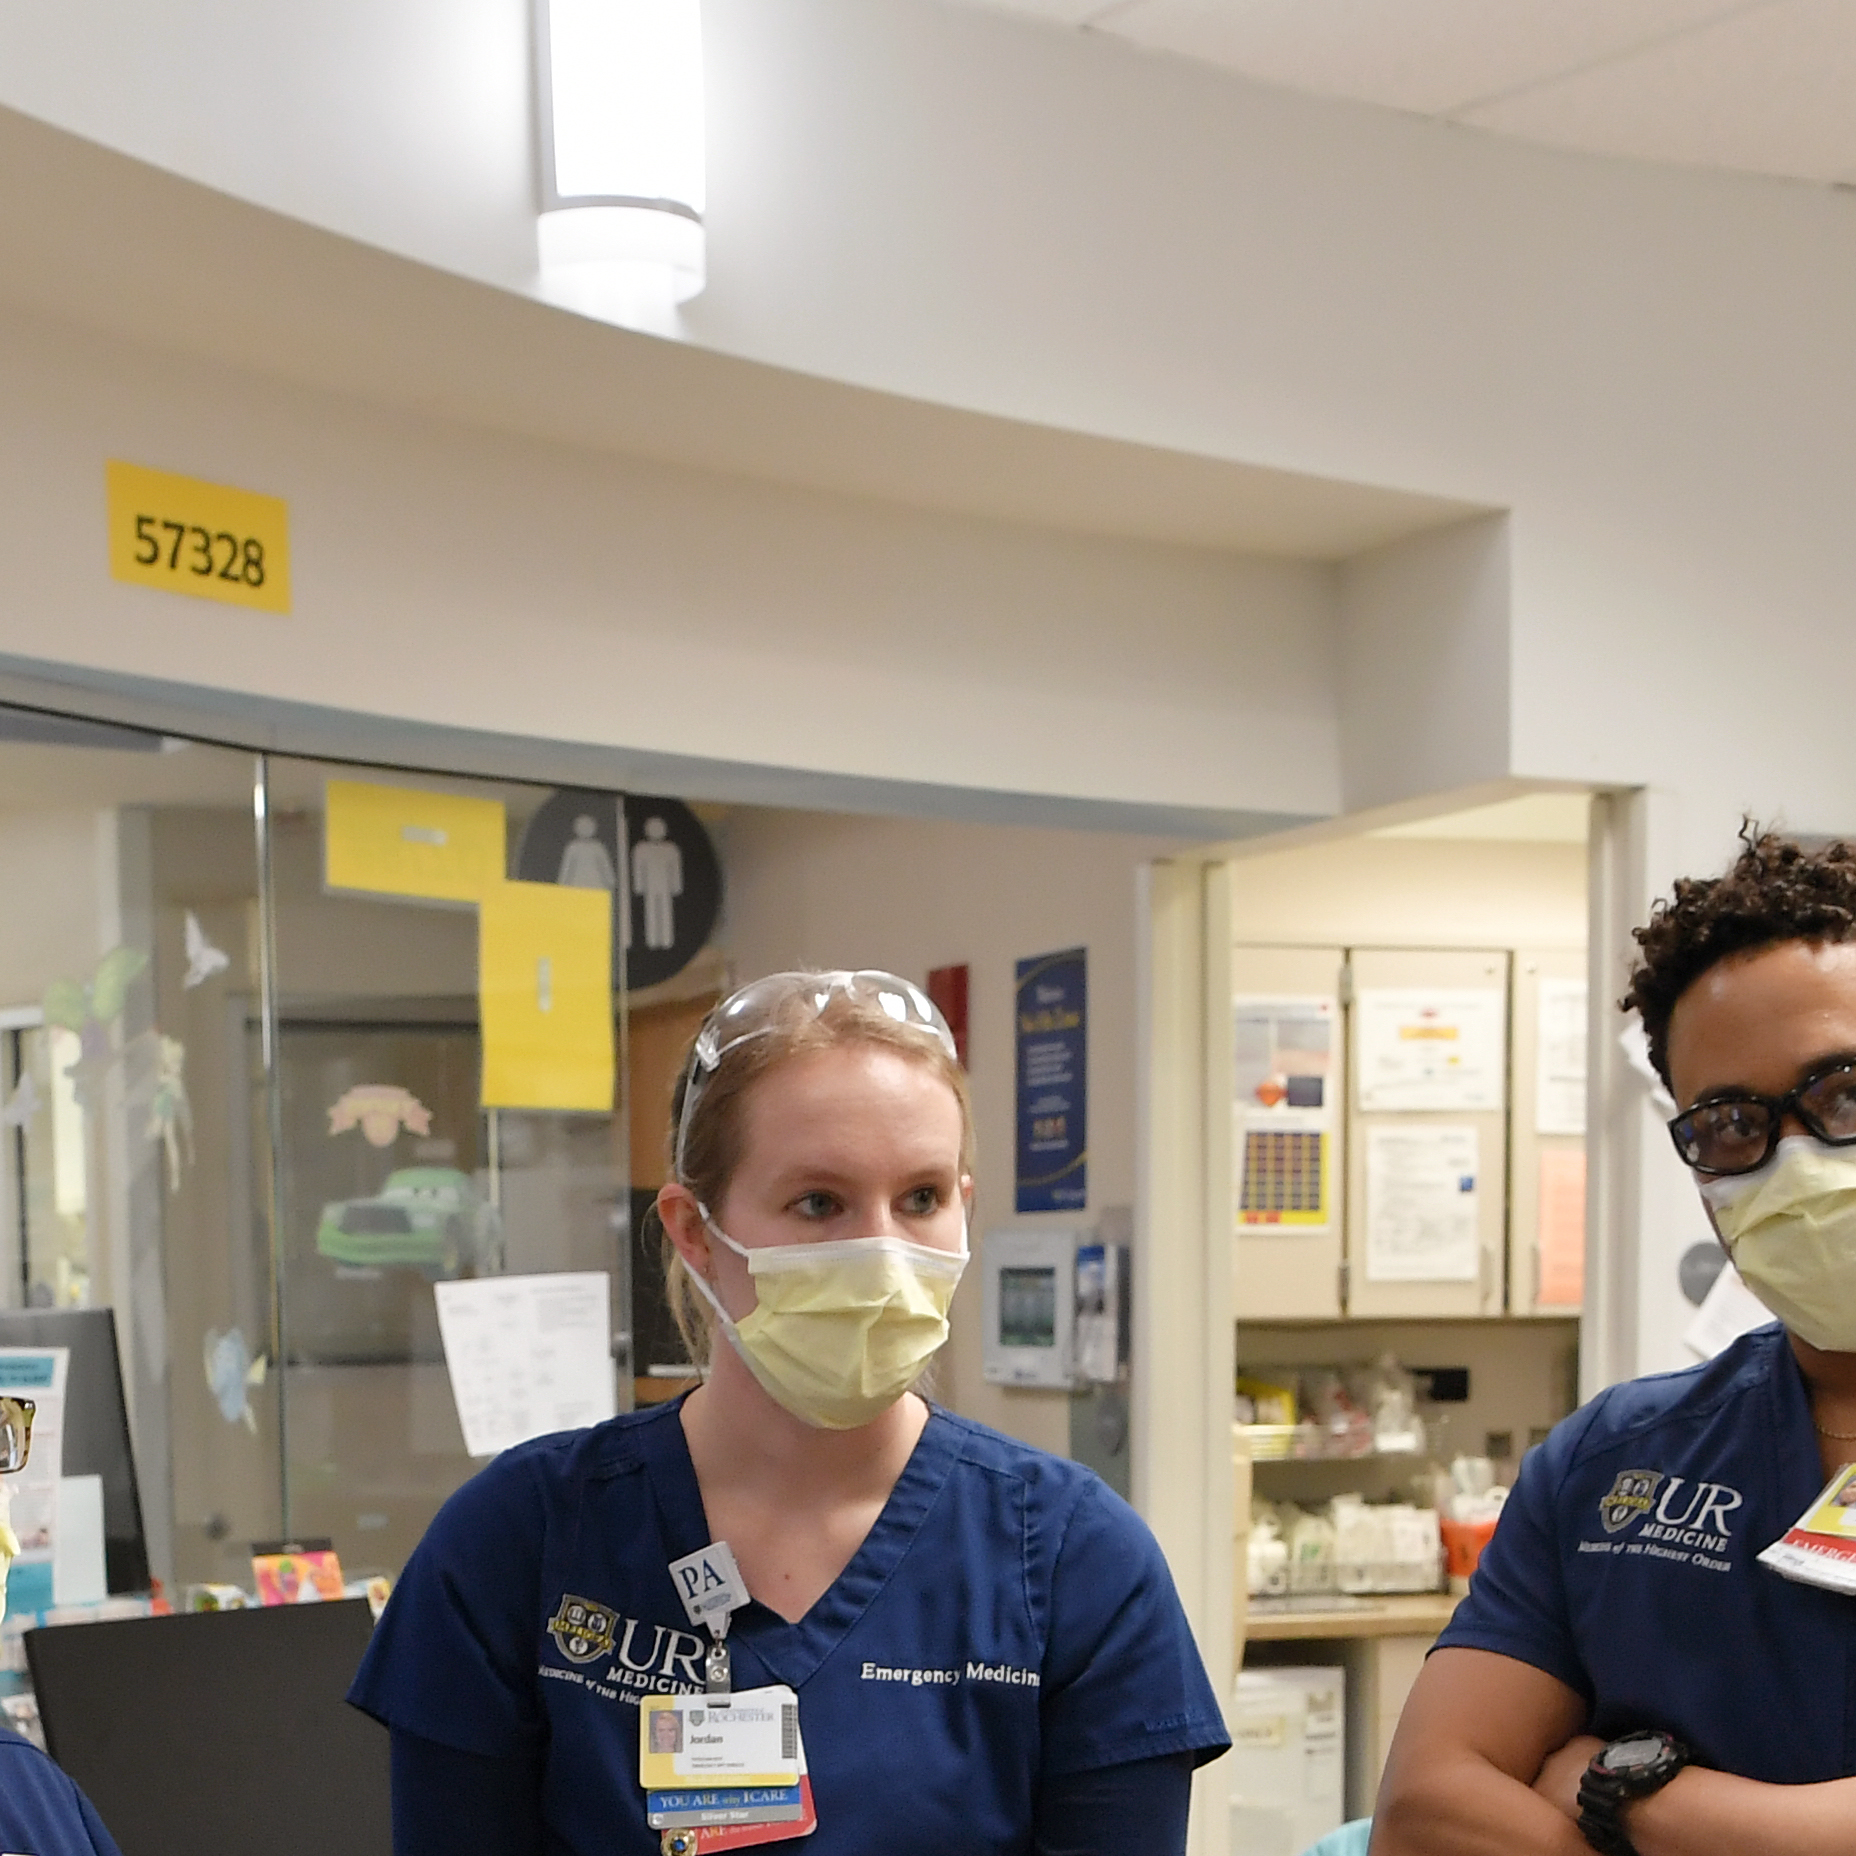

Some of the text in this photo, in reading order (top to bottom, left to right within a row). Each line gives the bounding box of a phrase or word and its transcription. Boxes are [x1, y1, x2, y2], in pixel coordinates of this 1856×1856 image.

[136, 514, 265, 587] 57328
[1655, 1477, 1743, 1537] UR
[1638, 1522, 1728, 1552] MEDICINE
[678, 1558, 726, 1600] PA
[619, 1618, 707, 1685] UR
[606, 1666, 707, 1696] MEDICINE
[861, 1661, 1041, 1687] Emergency Medicin
[690, 1734, 724, 1745] Jordan
[660, 1796, 691, 1809] YOU
[693, 1793, 719, 1806] ARE
[701, 1826, 726, 1839] ARE
